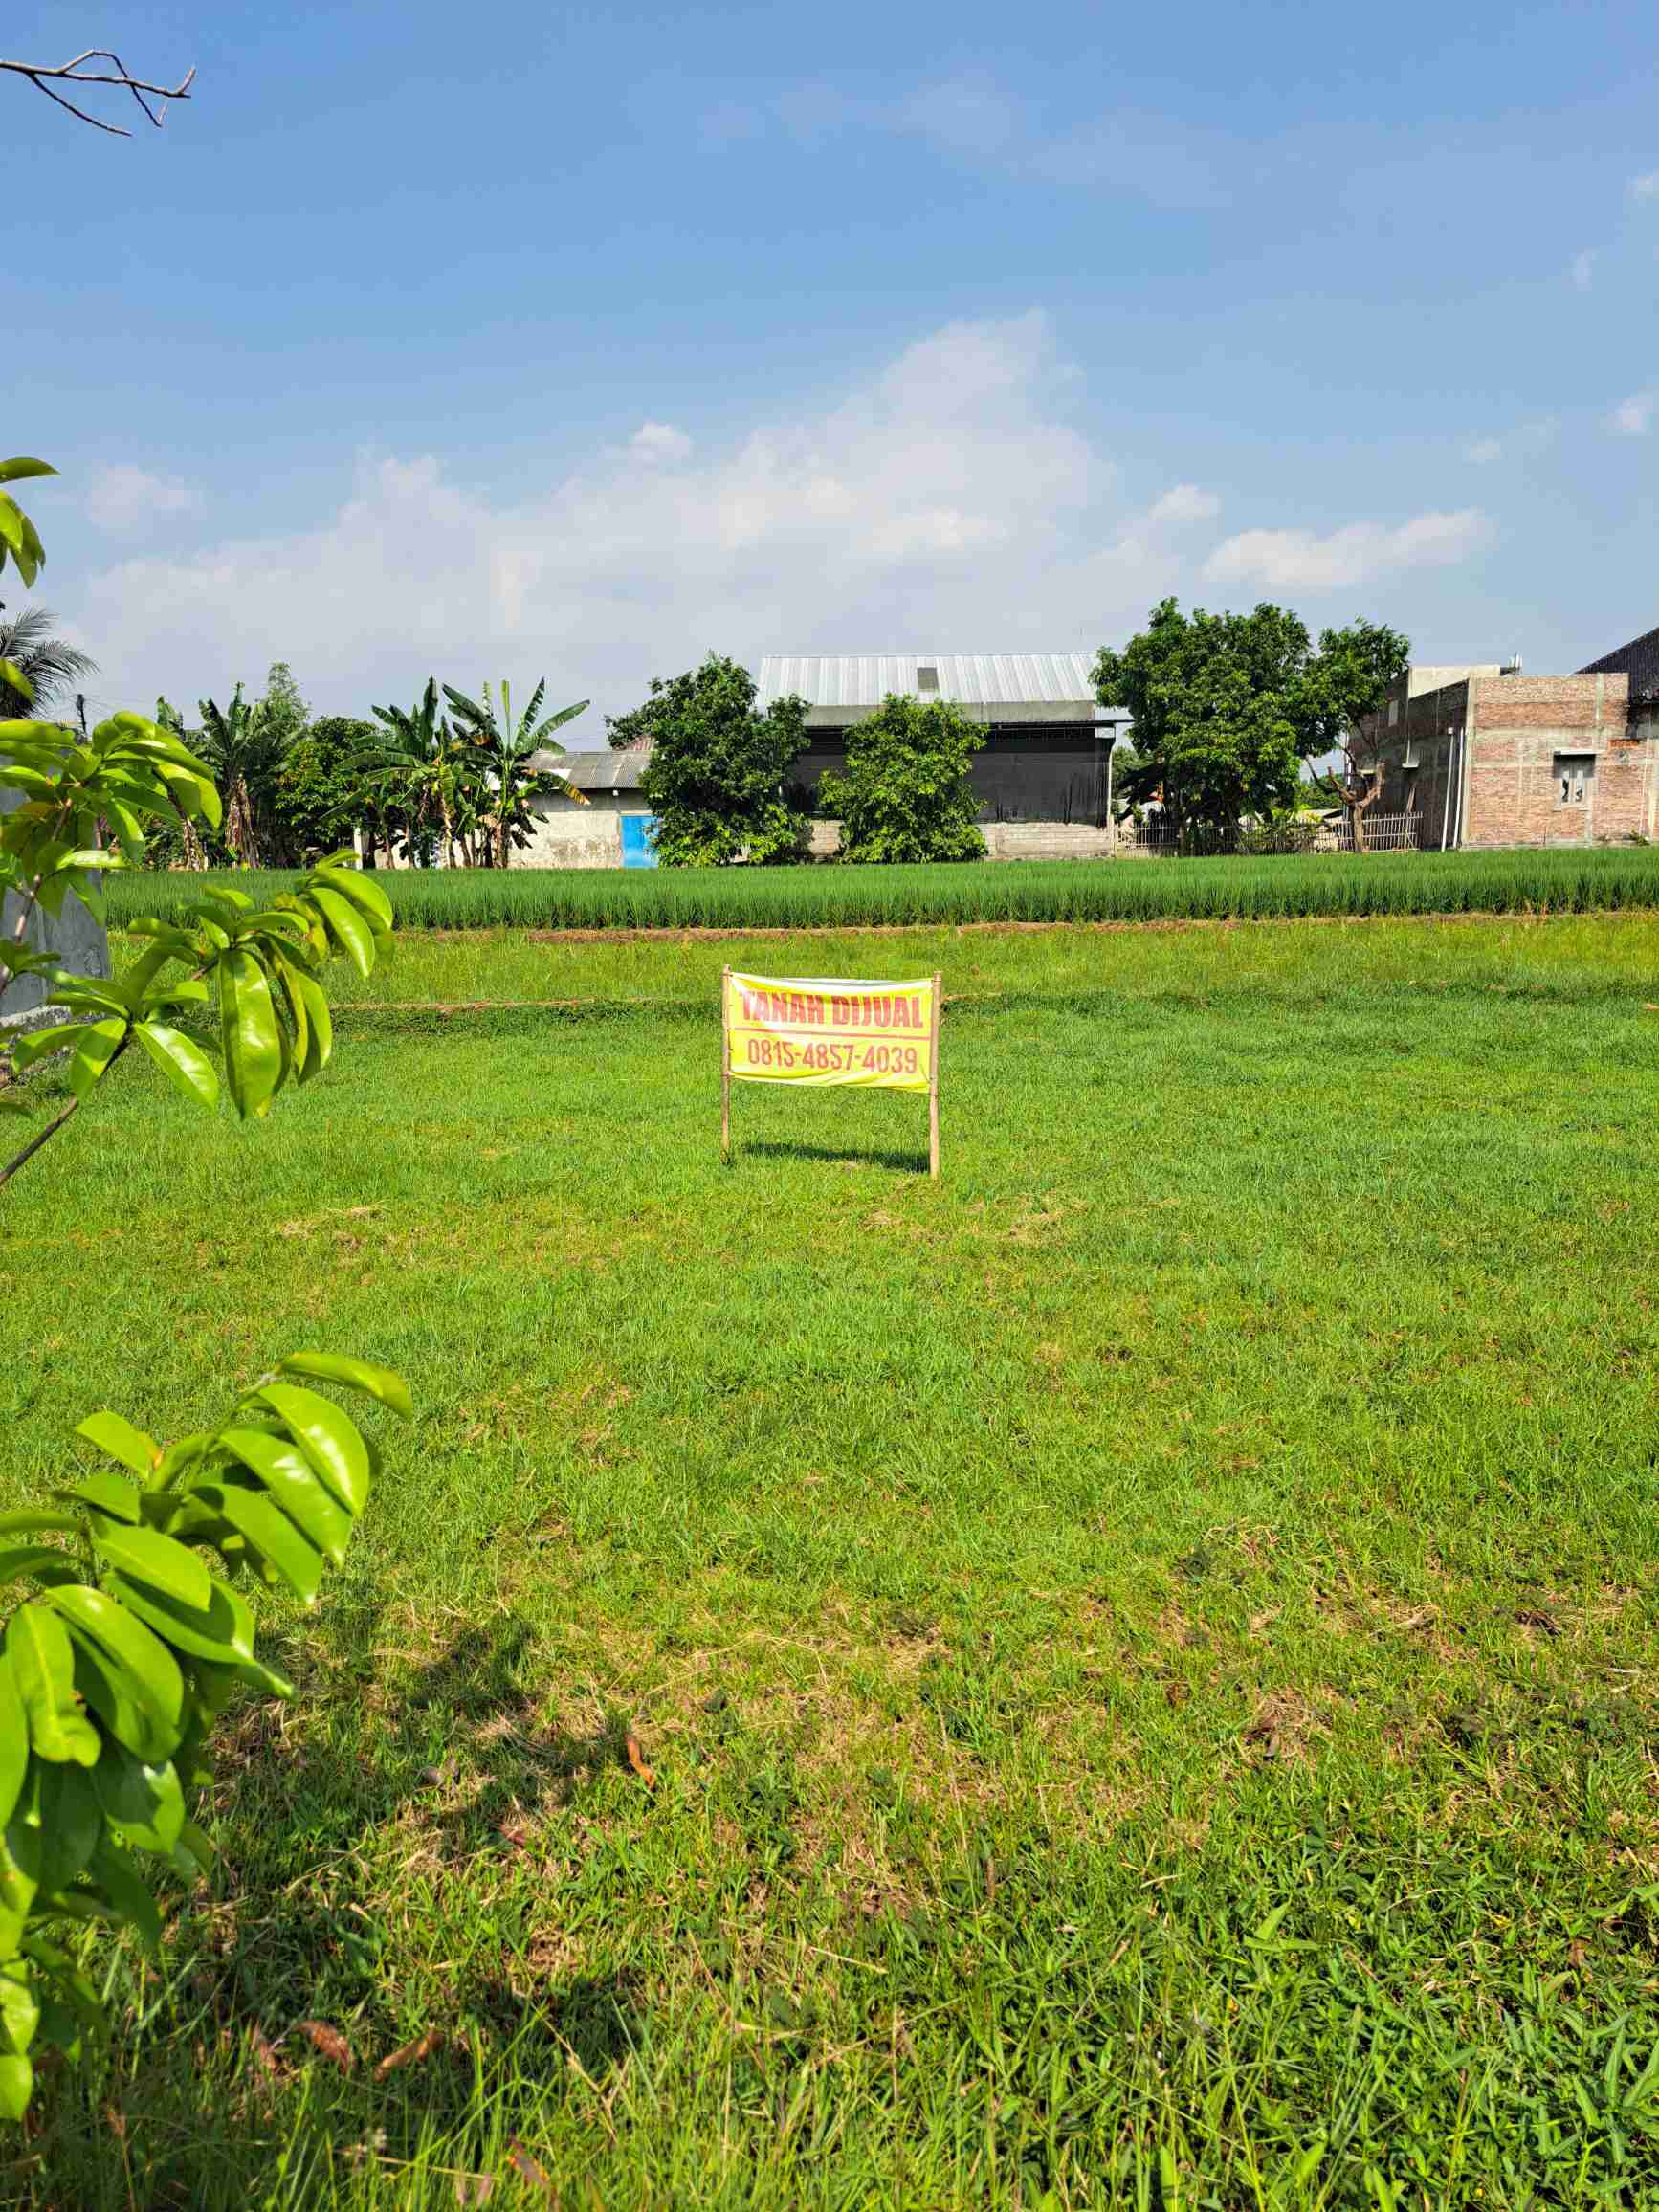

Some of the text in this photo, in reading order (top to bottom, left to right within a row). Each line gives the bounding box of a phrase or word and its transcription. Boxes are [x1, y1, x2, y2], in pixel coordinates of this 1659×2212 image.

[741, 990, 923, 1028] TANAH DIJUAL
[747, 1038, 918, 1073] 0815-4857-4039
